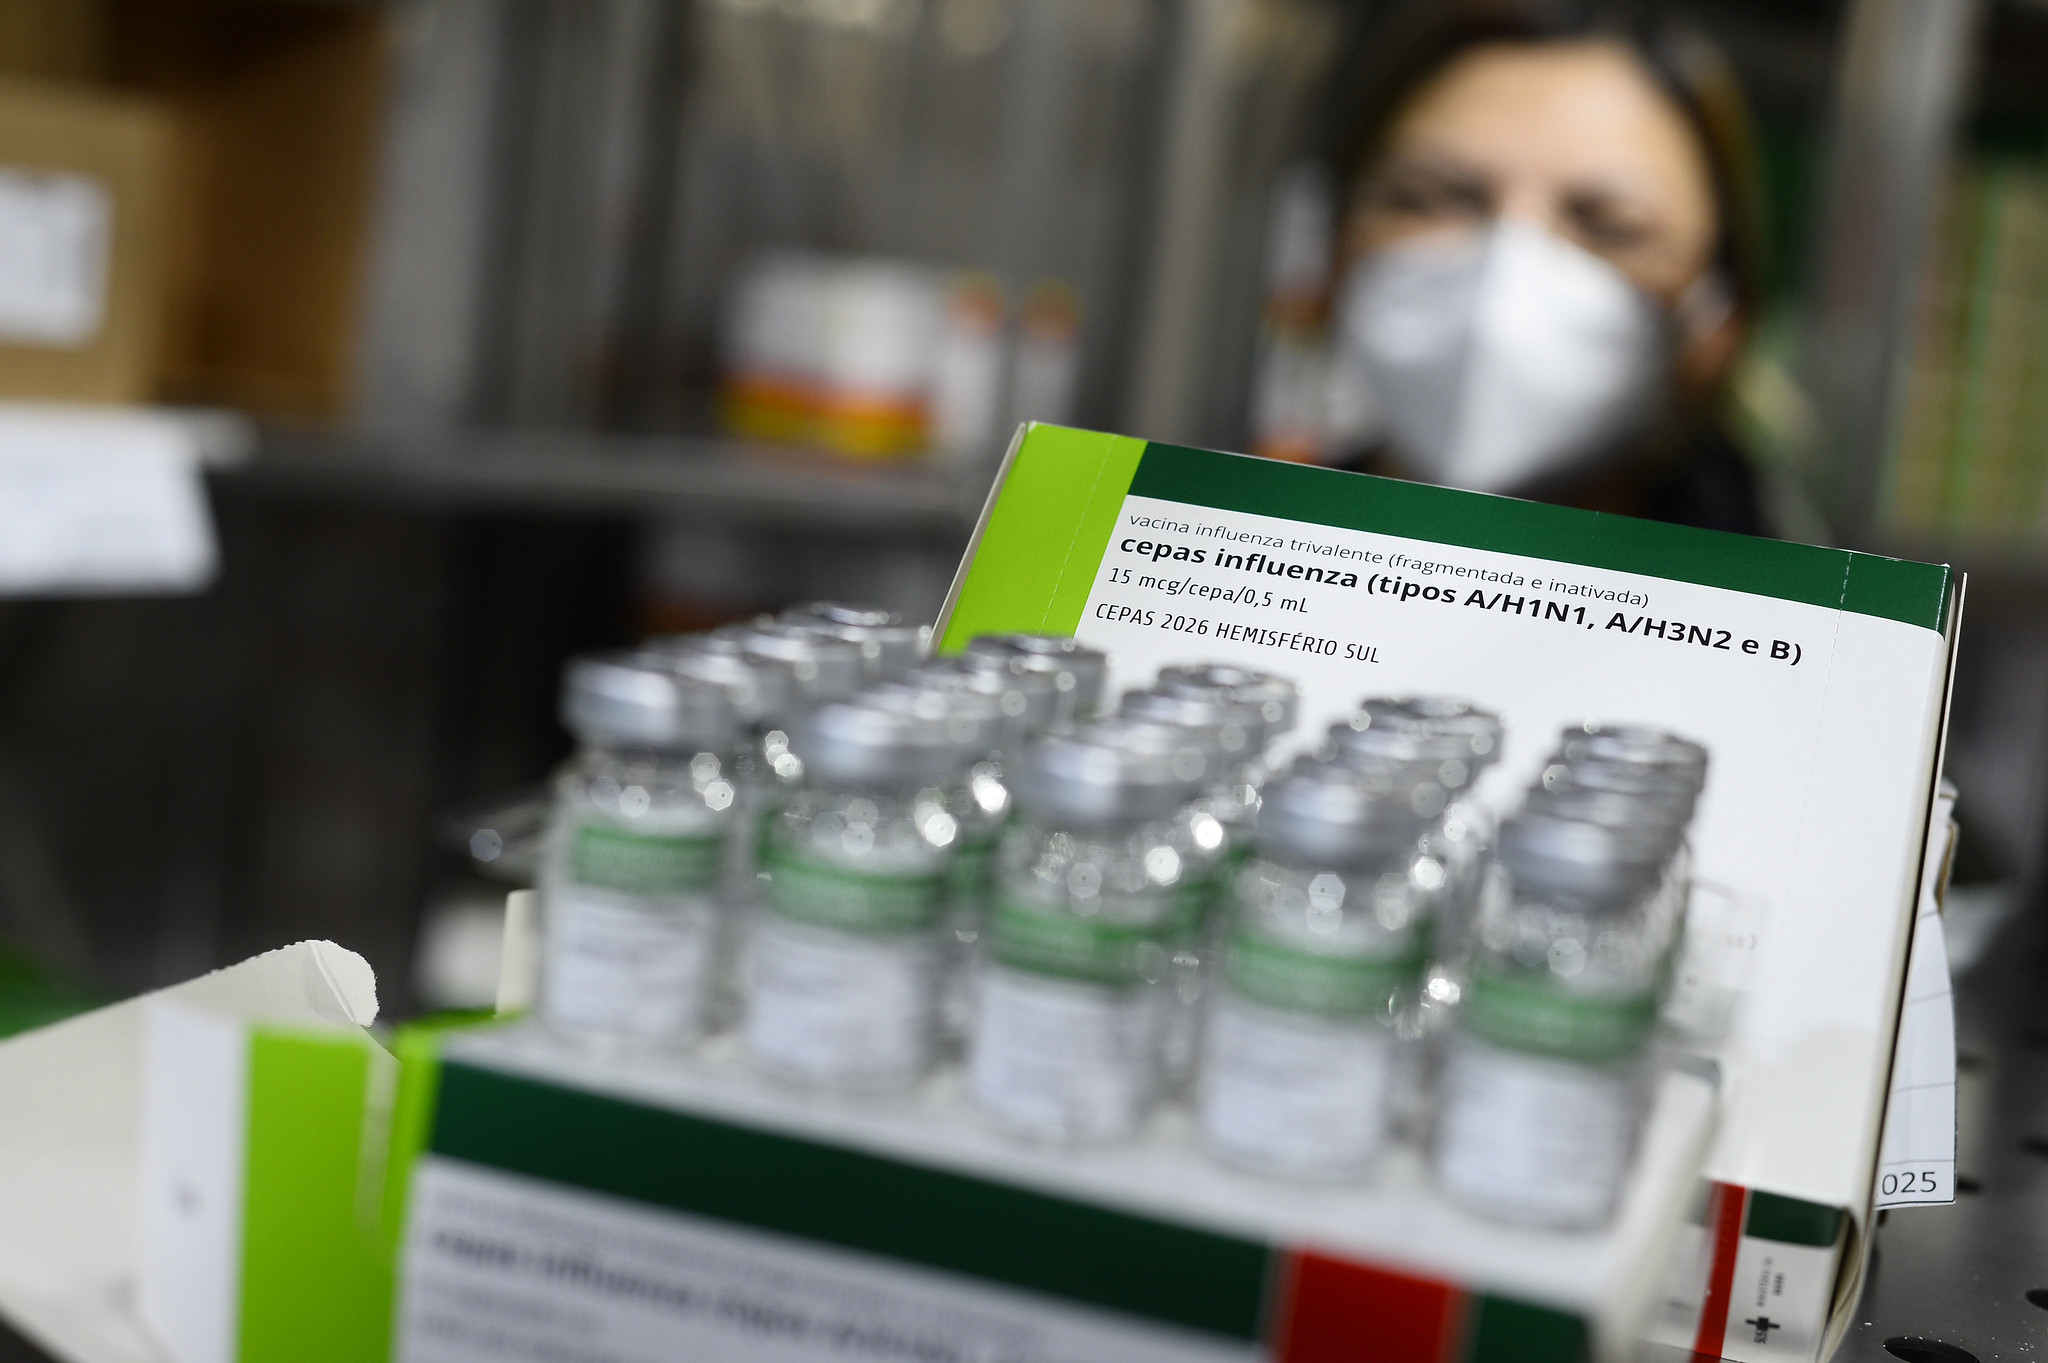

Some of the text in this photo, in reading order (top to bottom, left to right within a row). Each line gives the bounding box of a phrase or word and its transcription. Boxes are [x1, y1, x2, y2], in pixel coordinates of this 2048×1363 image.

[1108, 567, 1309, 614] 15 mcg/cepa/0,5 mL
[1130, 515, 1649, 609] vacina influenza trivalente (fragmentada e inativada)
[1120, 538, 1802, 667] cepas influenza (tipos A/H1N1, A/H3N2 e B)
[1095, 603, 1380, 664] CEPAS 2026 HEMISFÉRIO SUL
[1881, 1171, 1937, 1196] 025
